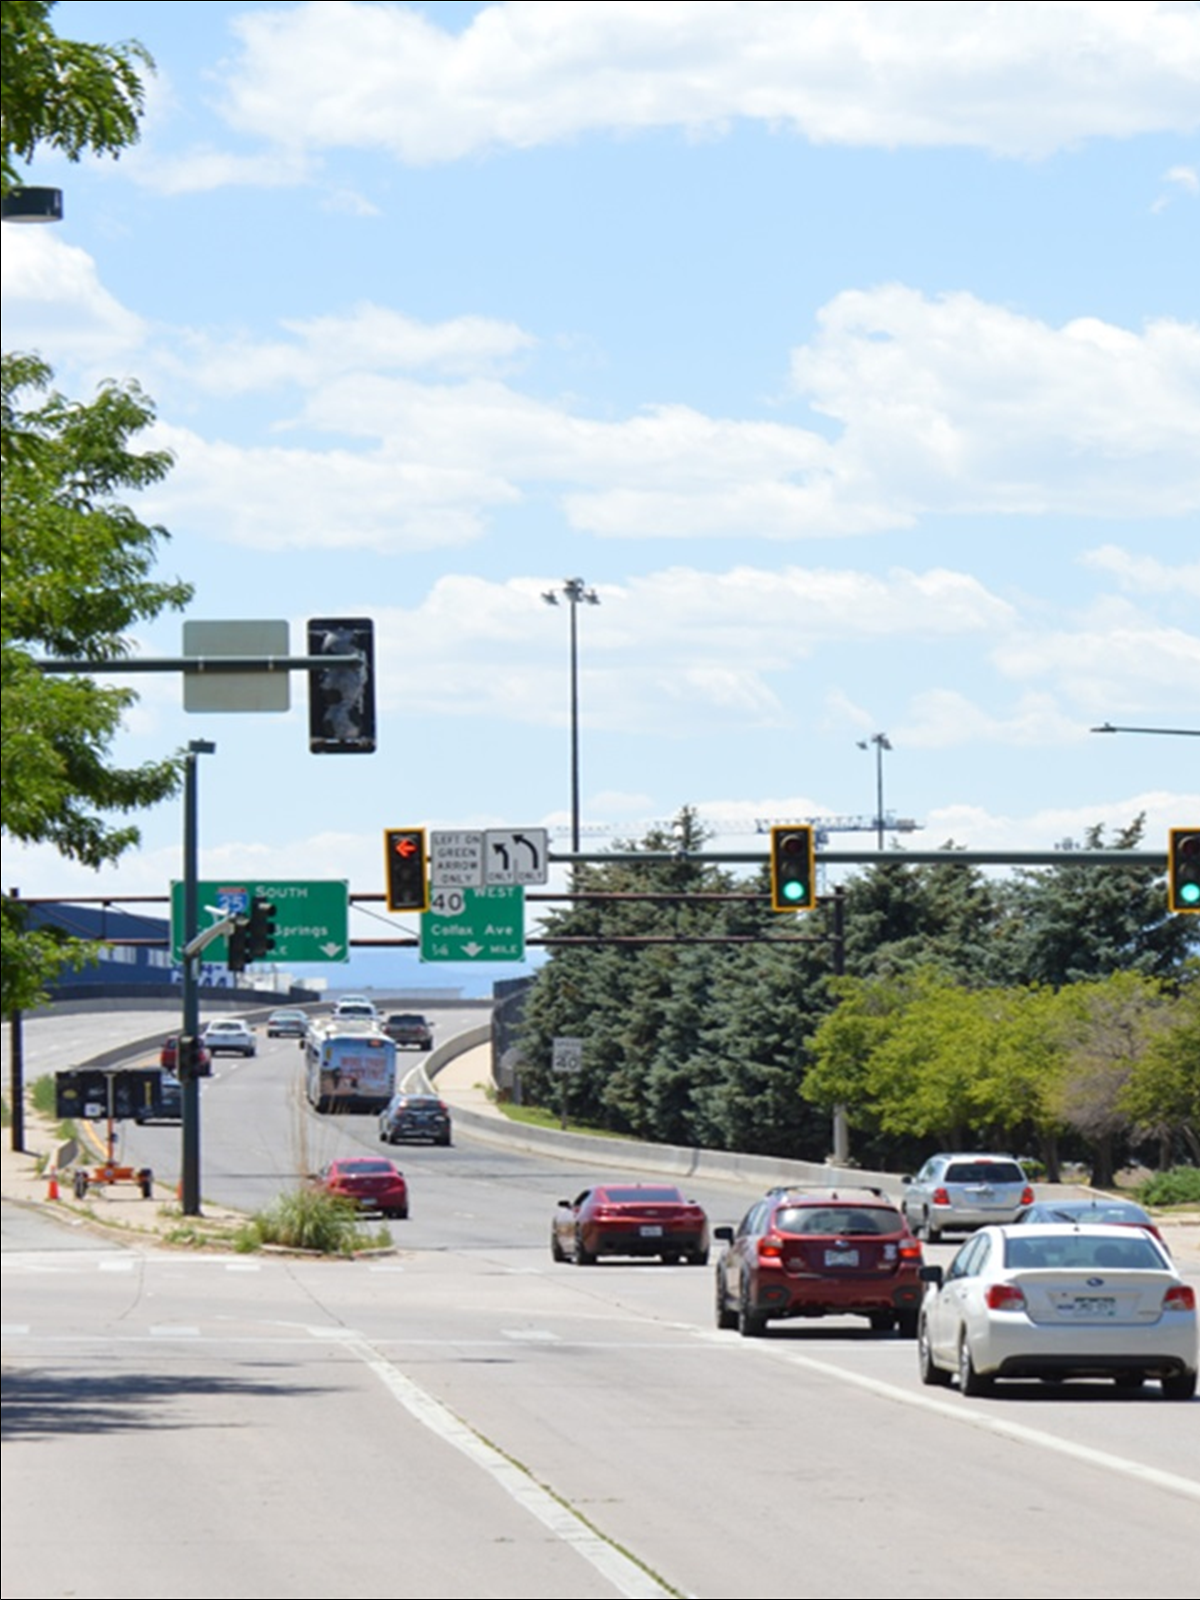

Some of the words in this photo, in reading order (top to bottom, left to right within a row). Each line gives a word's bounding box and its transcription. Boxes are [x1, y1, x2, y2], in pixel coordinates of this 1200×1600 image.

[435, 835, 460, 845] LEFT
[465, 835, 480, 845] ON
[437, 848, 477, 858] GREEN
[437, 861, 478, 870] ARROW
[441, 873, 473, 883] ONLY
[489, 872, 512, 880] ONLY
[520, 872, 542, 880] ONLY
[255, 885, 308, 899] SOUTH
[473, 887, 515, 898] WEST
[218, 896, 244, 912] 25
[432, 893, 462, 912] 40
[430, 924, 474, 936] Colfax
[484, 924, 513, 936] Ave
[489, 945, 517, 954] MILE
